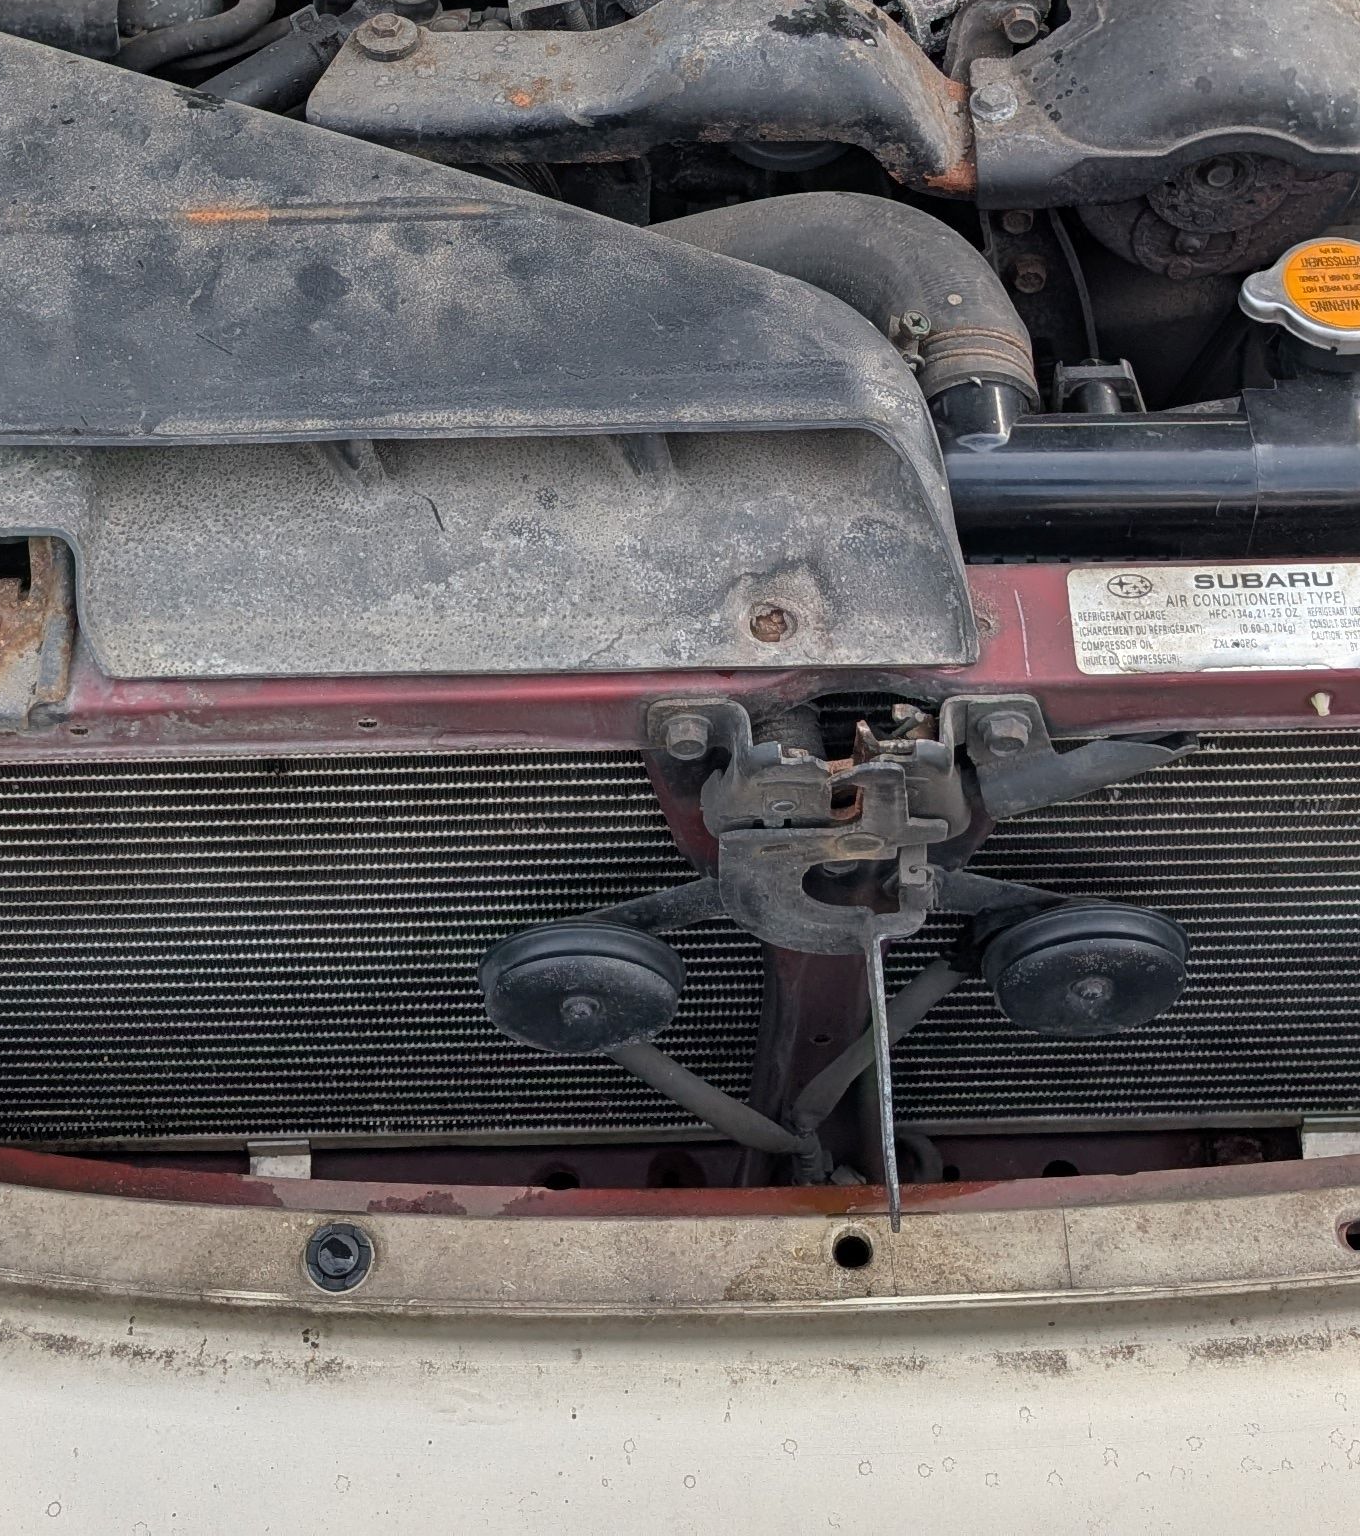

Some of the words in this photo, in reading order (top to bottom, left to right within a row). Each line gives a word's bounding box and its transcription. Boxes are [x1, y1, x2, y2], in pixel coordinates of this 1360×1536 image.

[1194, 572, 1334, 589] SUBARU
[1165, 594, 1188, 607] AIR
[1193, 591, 1346, 607] CONDITIONER(LI-TYPE)
[1078, 611, 1131, 621] REFRIGERANT
[1134, 610, 1167, 620] CHARGE
[1079, 625, 1134, 637] (CHARGEMENT
[1136, 625, 1147, 635] DU
[1081, 639, 1137, 651] COMPRESSOR
